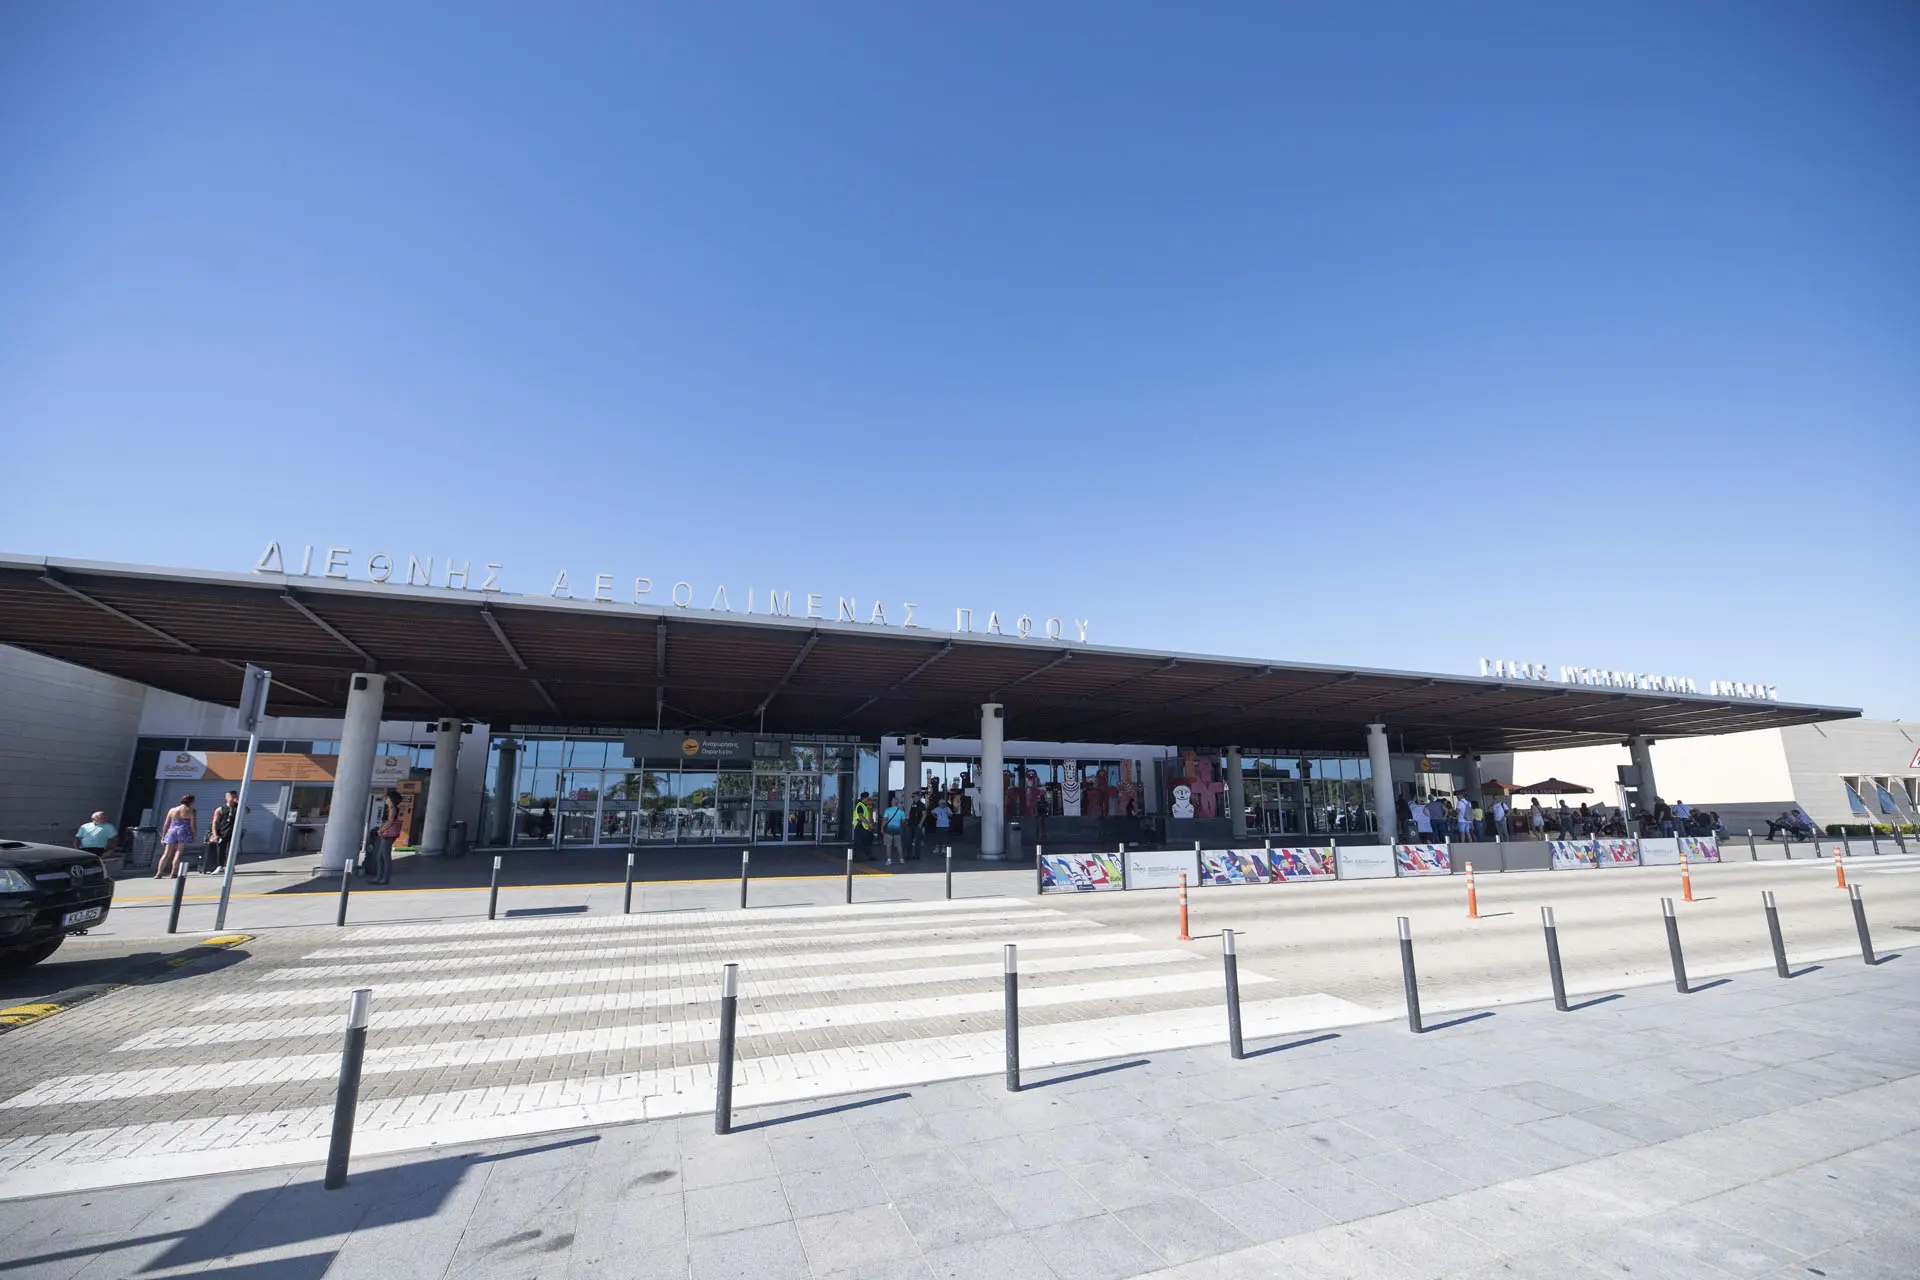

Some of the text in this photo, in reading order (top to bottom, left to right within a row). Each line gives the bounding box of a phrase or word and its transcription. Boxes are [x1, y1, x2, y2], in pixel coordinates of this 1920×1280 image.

[254, 541, 1089, 644] ΔΙΕΘΝΗΣ ΑΕΡΟΛΙΜΕΝΑΣ ΠΑΦΟΥ
